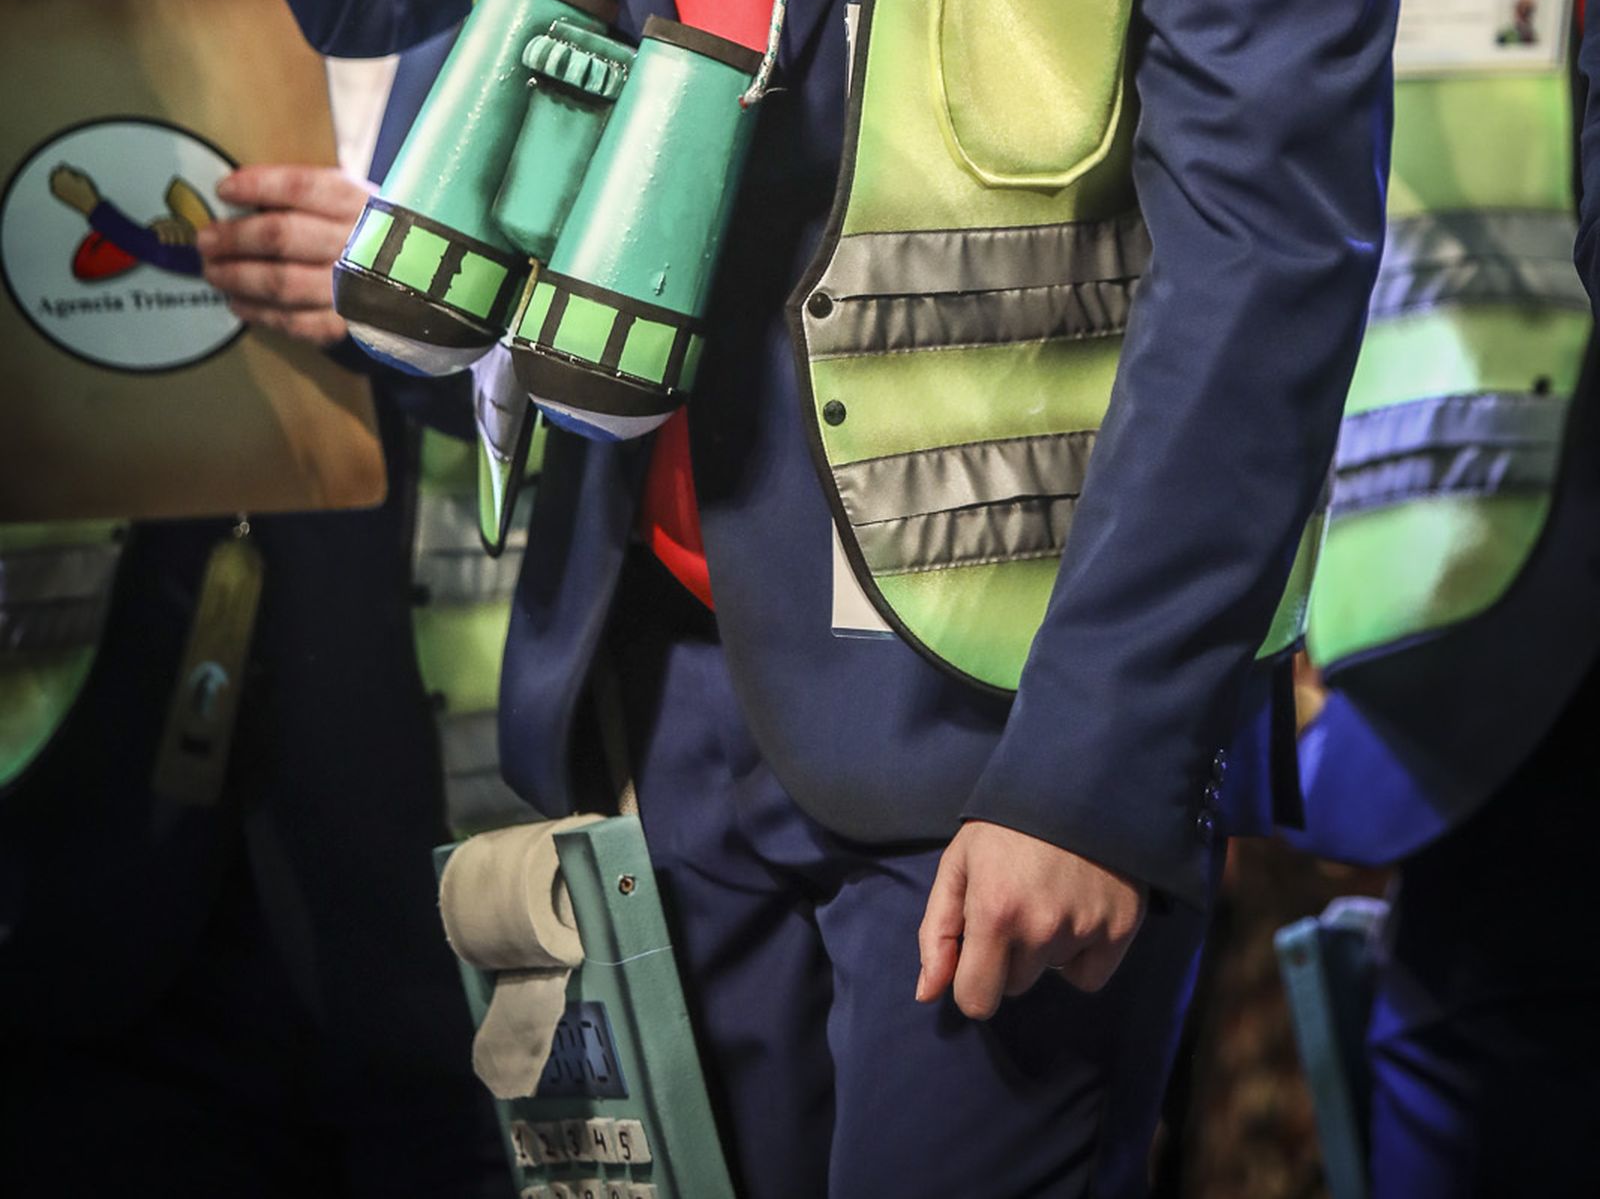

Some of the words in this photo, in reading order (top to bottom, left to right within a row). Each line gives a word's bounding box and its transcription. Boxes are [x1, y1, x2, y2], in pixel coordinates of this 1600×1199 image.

[39, 291, 124, 318] Agencia
[593, 1128, 607, 1153] 4
[618, 1131, 632, 1161] 5
